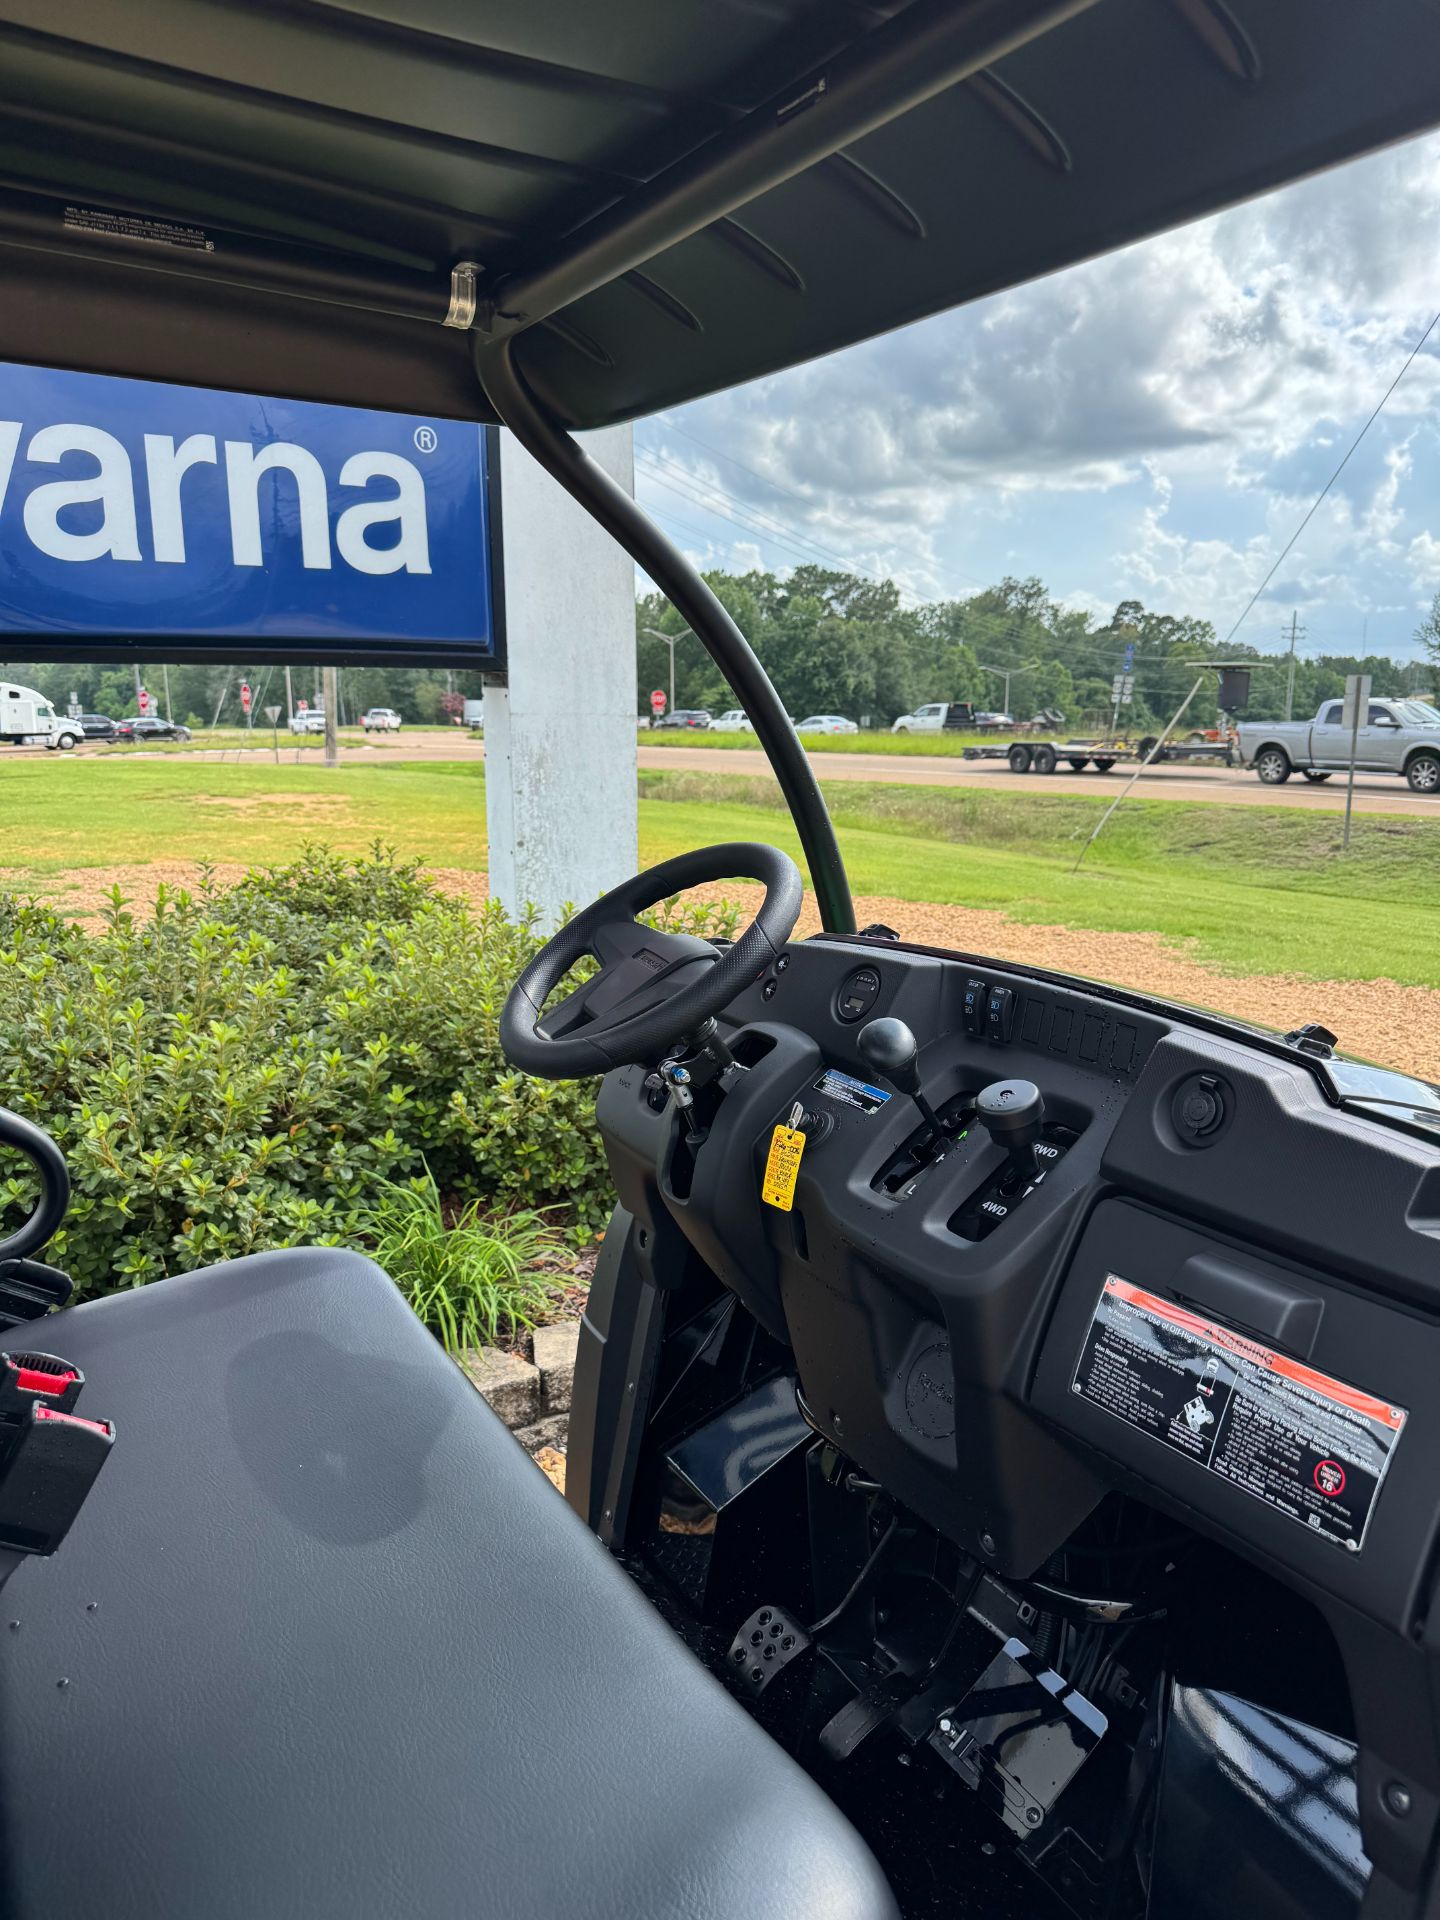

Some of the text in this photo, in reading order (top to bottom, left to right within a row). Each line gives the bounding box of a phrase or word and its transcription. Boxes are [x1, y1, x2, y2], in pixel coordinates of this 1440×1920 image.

[981, 1201, 1008, 1216] 4WD
[1118, 1300, 1147, 1320] Improper
[1147, 1314, 1161, 1326] Use
[1160, 1320, 1170, 1330] of
[1209, 1343, 1239, 1364] Vehicles
[1240, 1358, 1256, 1372] Can
[1256, 1366, 1281, 1385] Cause
[1280, 1378, 1310, 1399] Severe
[1309, 1392, 1334, 1411] Injury
[1333, 1405, 1345, 1416] or
[1345, 1408, 1372, 1428] Death
[1252, 1412, 1272, 1429] Proper
[1272, 1423, 1285, 1434] Use
[1293, 1433, 1307, 1446] Your
[1308, 1441, 1330, 1457] Vehicle
[1320, 1477, 1334, 1492] 16
